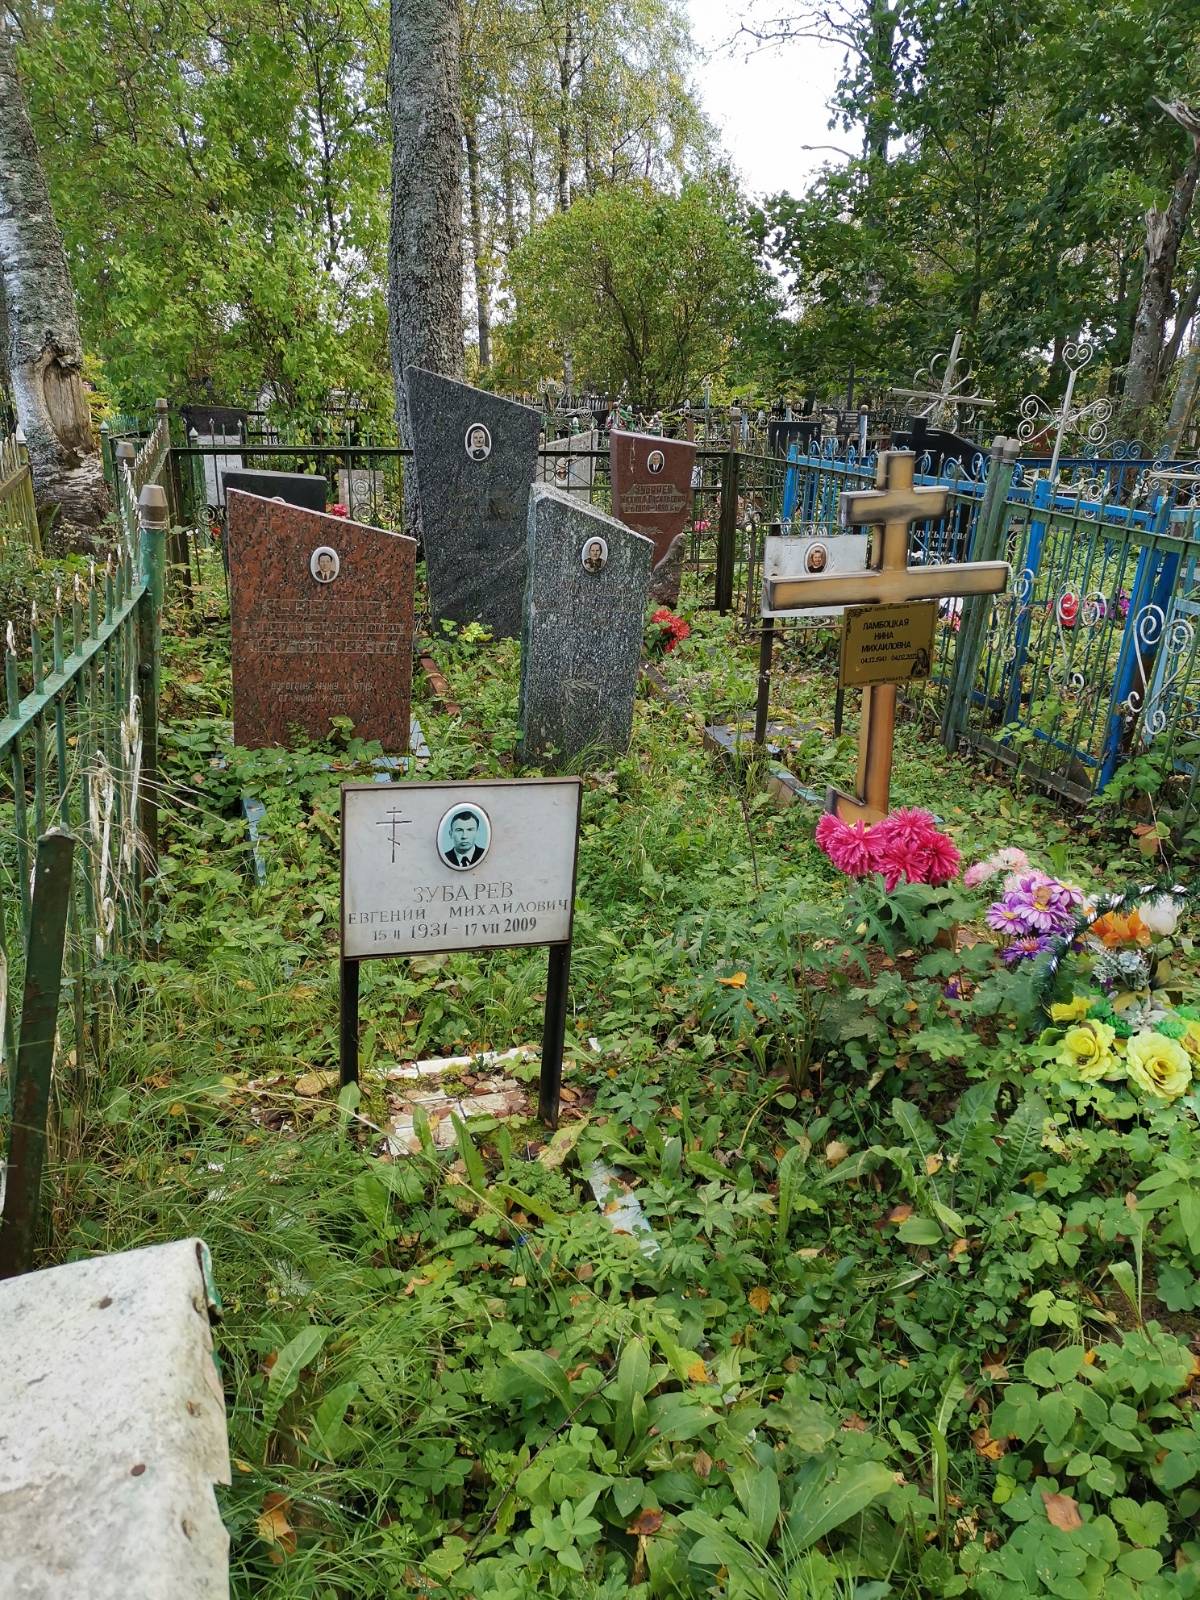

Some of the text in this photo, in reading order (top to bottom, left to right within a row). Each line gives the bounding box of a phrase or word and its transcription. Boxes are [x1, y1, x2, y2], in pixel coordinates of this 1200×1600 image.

[874, 631, 894, 641] НИНА
[413, 881, 513, 903] ЗУБАРЕВ
[348, 899, 569, 925] ЕВГЕНИЙ МИХАЙЛОВИЧ
[373, 929, 388, 941] 15
[410, 921, 448, 939] 1931
[465, 923, 479, 936] 17
[503, 916, 537, 933] 2009
